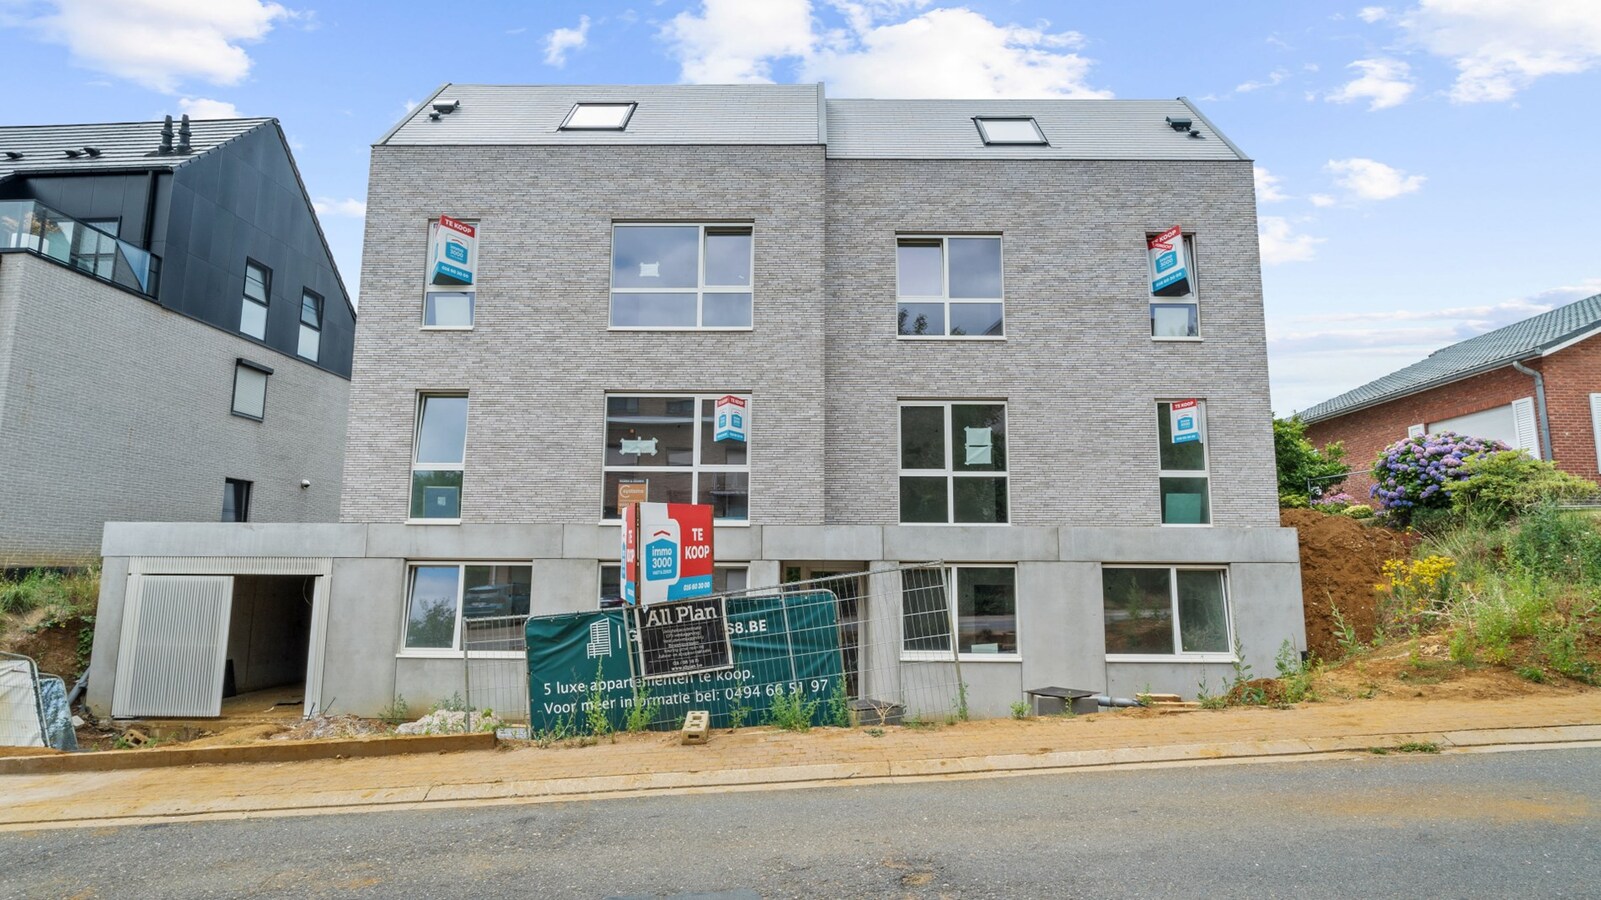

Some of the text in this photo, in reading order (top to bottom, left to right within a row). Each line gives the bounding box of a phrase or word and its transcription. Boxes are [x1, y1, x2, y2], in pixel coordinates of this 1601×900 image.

[445, 218, 472, 234] TE KOOP
[1159, 229, 1177, 242] KOOP
[691, 527, 704, 541] TE
[651, 546, 673, 557] immo
[685, 545, 710, 560] KOOP
[651, 557, 673, 569] 3000
[646, 605, 718, 627] All Plan
[543, 682, 551, 695] 5
[556, 681, 585, 694] luxe
[700, 671, 711, 683] te
[716, 668, 755, 682] koop.
[543, 702, 576, 714] Voor
[695, 688, 720, 703] bel:
[725, 685, 760, 700] 0494
[765, 683, 784, 697] 66
[789, 681, 804, 695] 51
[811, 679, 828, 693] 97
